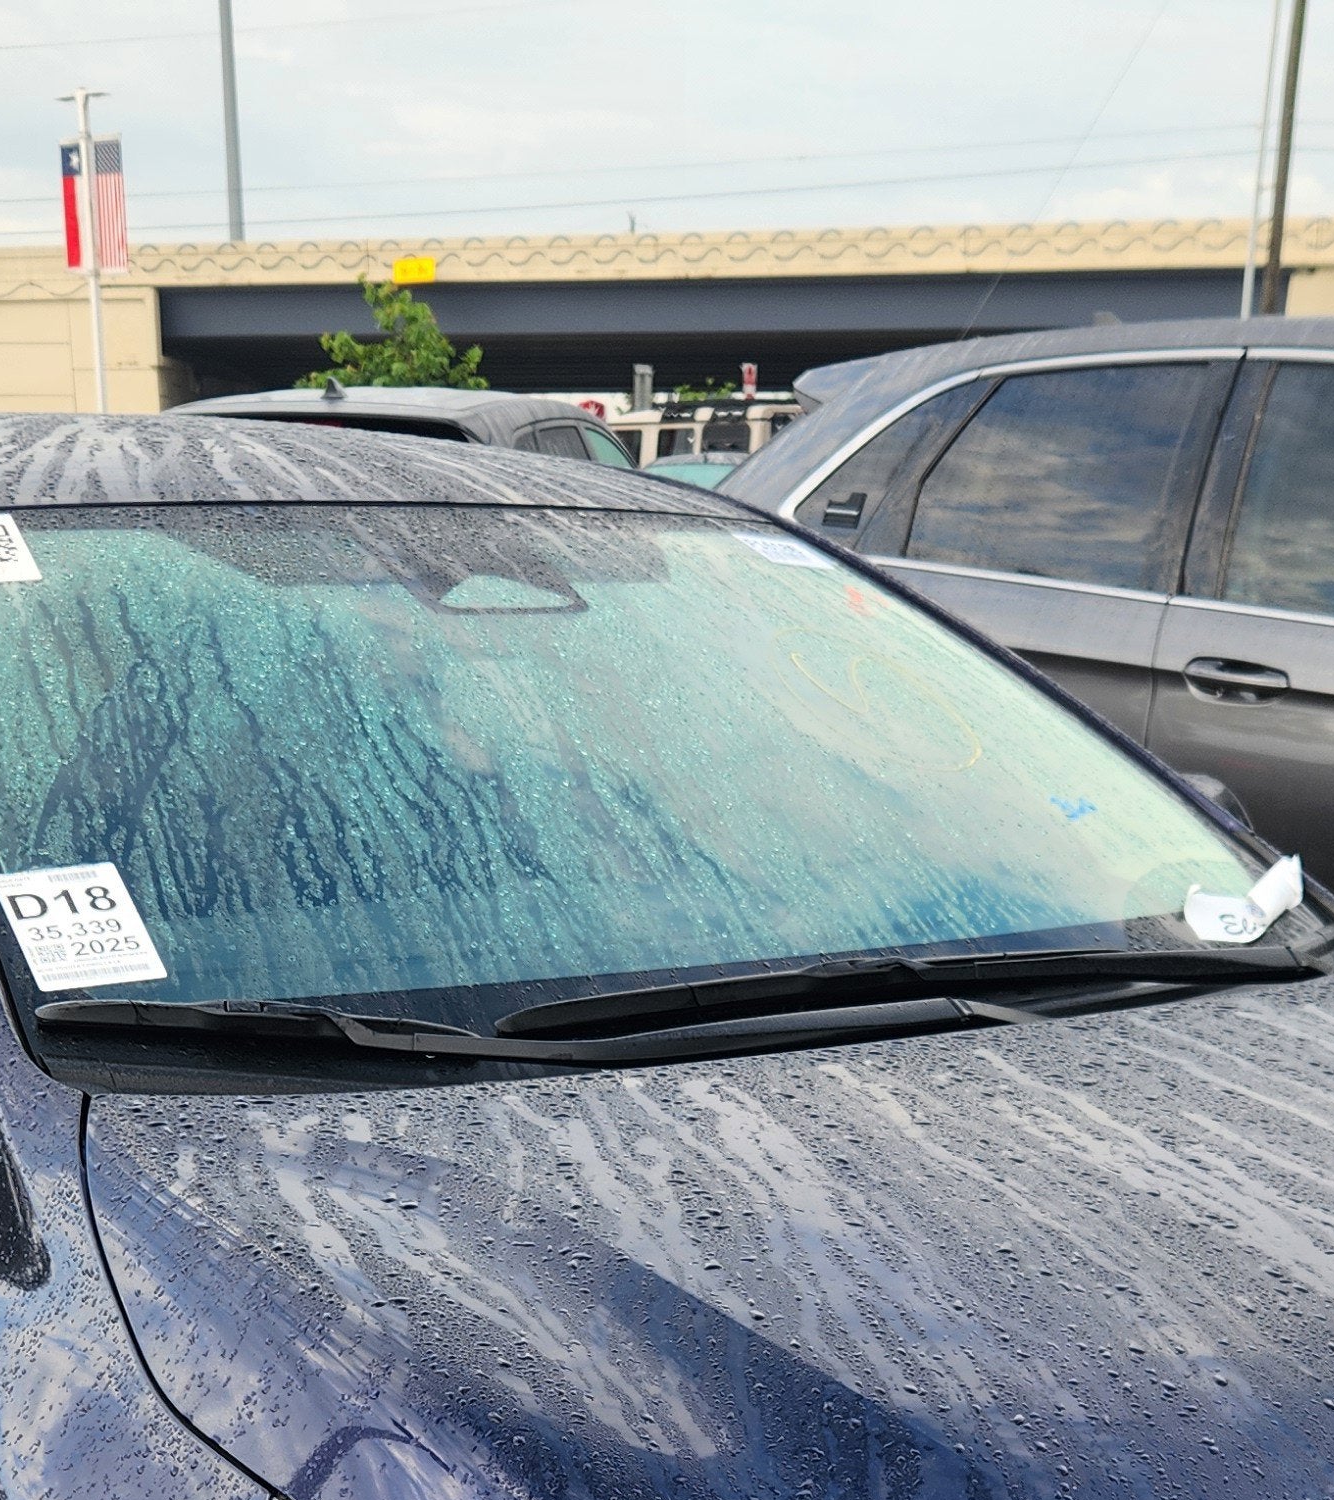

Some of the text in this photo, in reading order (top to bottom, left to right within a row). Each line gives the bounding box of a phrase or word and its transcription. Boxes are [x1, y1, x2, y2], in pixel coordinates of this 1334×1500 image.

[6, 886, 117, 920] D18
[28, 918, 122, 942] 35,339
[71, 936, 140, 956] 2025
